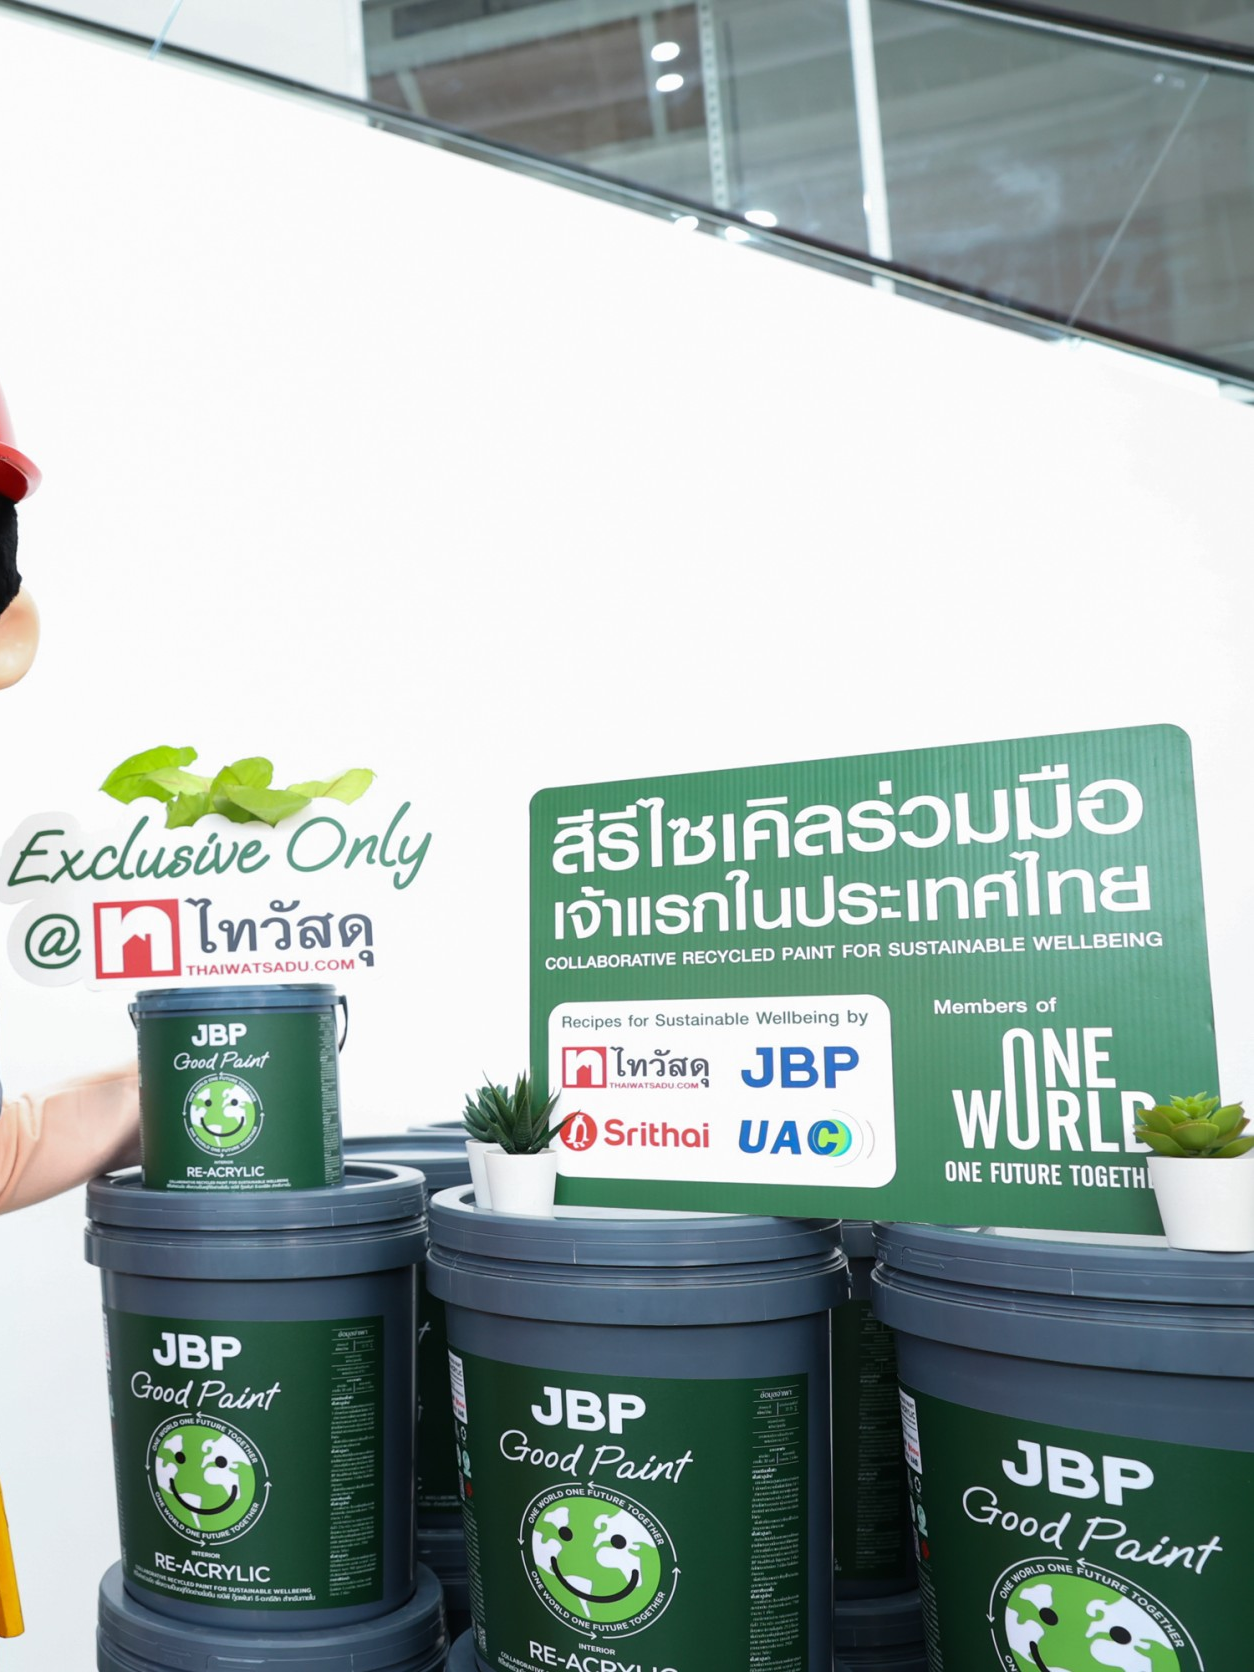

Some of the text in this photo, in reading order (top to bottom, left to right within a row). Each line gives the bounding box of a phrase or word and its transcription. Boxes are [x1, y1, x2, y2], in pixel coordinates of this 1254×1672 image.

[552, 763, 1144, 874] สีรีไซเคิลร่วมมือ
[8, 801, 432, 890] Exclusive Only
[554, 851, 1151, 940] เจ้าแรกในประเทศไทย
[24, 913, 82, 970] @
[185, 898, 375, 967] ไทวัสดุ
[545, 931, 1163, 970] COLLABORATIVE RECYCLED PAINT FOR SUSTAINABLE WELLBEING
[186, 959, 355, 977] THAIWATSADU.COM
[562, 1010, 869, 1030] Recipes for Sustainable Wellbeing by
[934, 997, 1057, 1015] Members of
[191, 1024, 247, 1047] JBP
[173, 1051, 270, 1071] Good Paint
[609, 1046, 710, 1088] ไทวัสดุ
[741, 1046, 859, 1089] JBP
[1002, 1027, 1116, 1092] ONE
[604, 1119, 710, 1148] Srithai
[738, 1120, 840, 1156] UAC
[186, 1166, 265, 1178] RE-ACRYLIC
[945, 1160, 1155, 1190] ONE FUTURE TOGETH
[152, 1332, 242, 1371] JBP
[131, 1371, 281, 1411] Good Paint
[531, 1385, 646, 1435] JBP
[152, 1437, 161, 1451] ONE
[158, 1421, 179, 1438] WORLD
[196, 1418, 226, 1432] FUTURE
[227, 1430, 258, 1464] TOGETHER
[499, 1429, 694, 1484] Good Paint
[1001, 1438, 1154, 1507] JBP
[155, 1491, 260, 1539] ONE WORLD ONE FUTURE TOGETHER
[528, 1488, 665, 1546] ONE WORLD ONE FUTURE TOGETHER
[962, 1486, 1224, 1575] Good Paint
[154, 1552, 271, 1583] RE-ACRYLIC
[191, 1550, 220, 1559] INTERIOR
[167, 1576, 195, 1588] RECYCLED
[195, 1582, 213, 1591] PAINT
[531, 1570, 666, 1632] ONE WORLD ONE FUTURE TOGETHER
[999, 1563, 1185, 1649] ONE WORLD ONE FUTURE TOGETHER
[578, 1642, 616, 1656] INTERIOR
